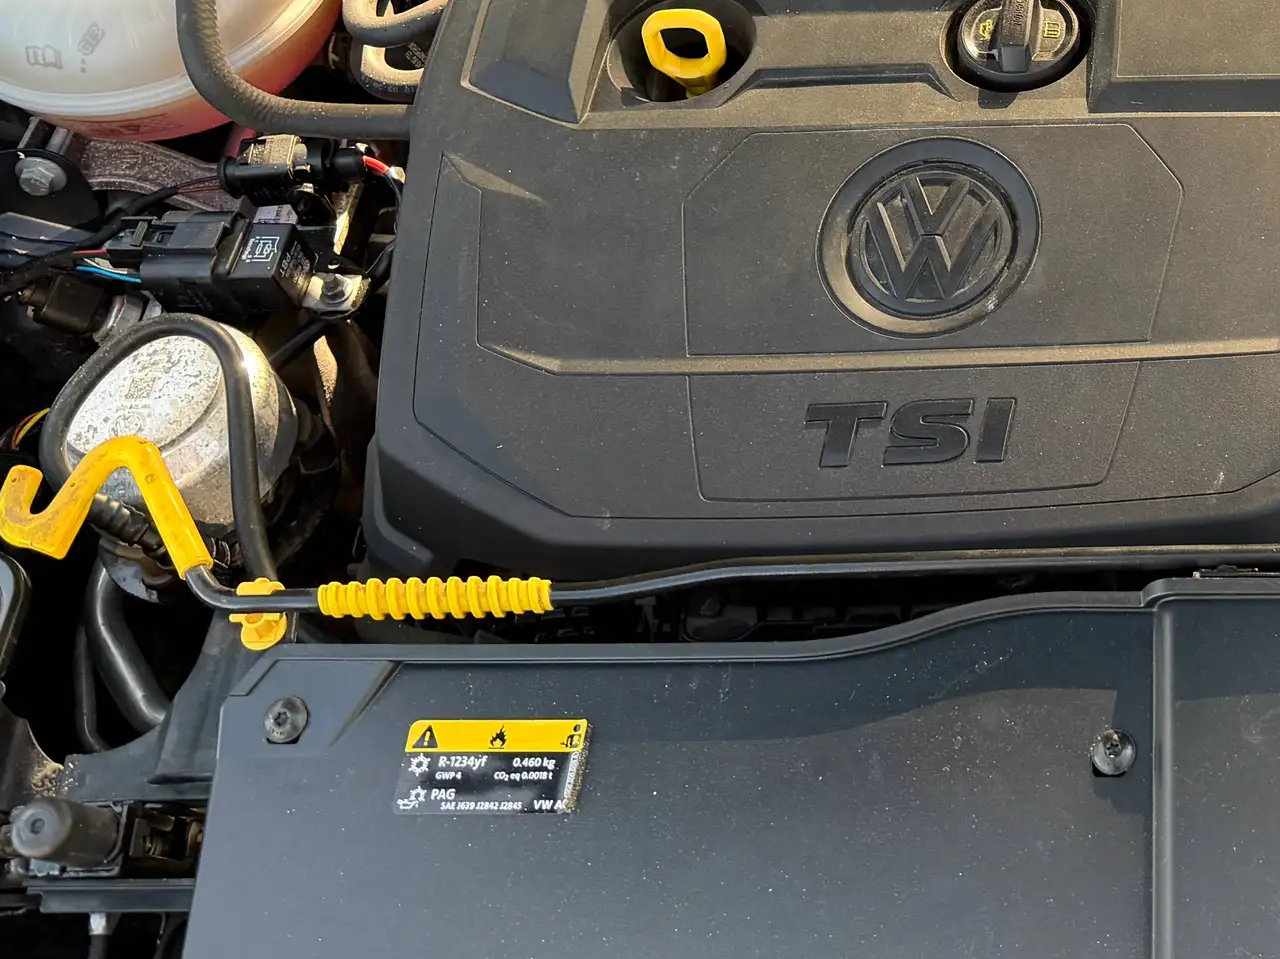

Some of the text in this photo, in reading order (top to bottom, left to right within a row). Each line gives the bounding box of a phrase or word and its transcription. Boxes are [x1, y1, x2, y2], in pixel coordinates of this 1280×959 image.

[804, 397, 1017, 467] TSI
[438, 755, 556, 770] R-1234yf 0.460 kg
[435, 771, 455, 780] GWP
[456, 771, 462, 779] 4
[509, 772, 521, 781] eq
[430, 788, 456, 800] PAG
[440, 801, 456, 810] SAE
[533, 799, 553, 810] VW
